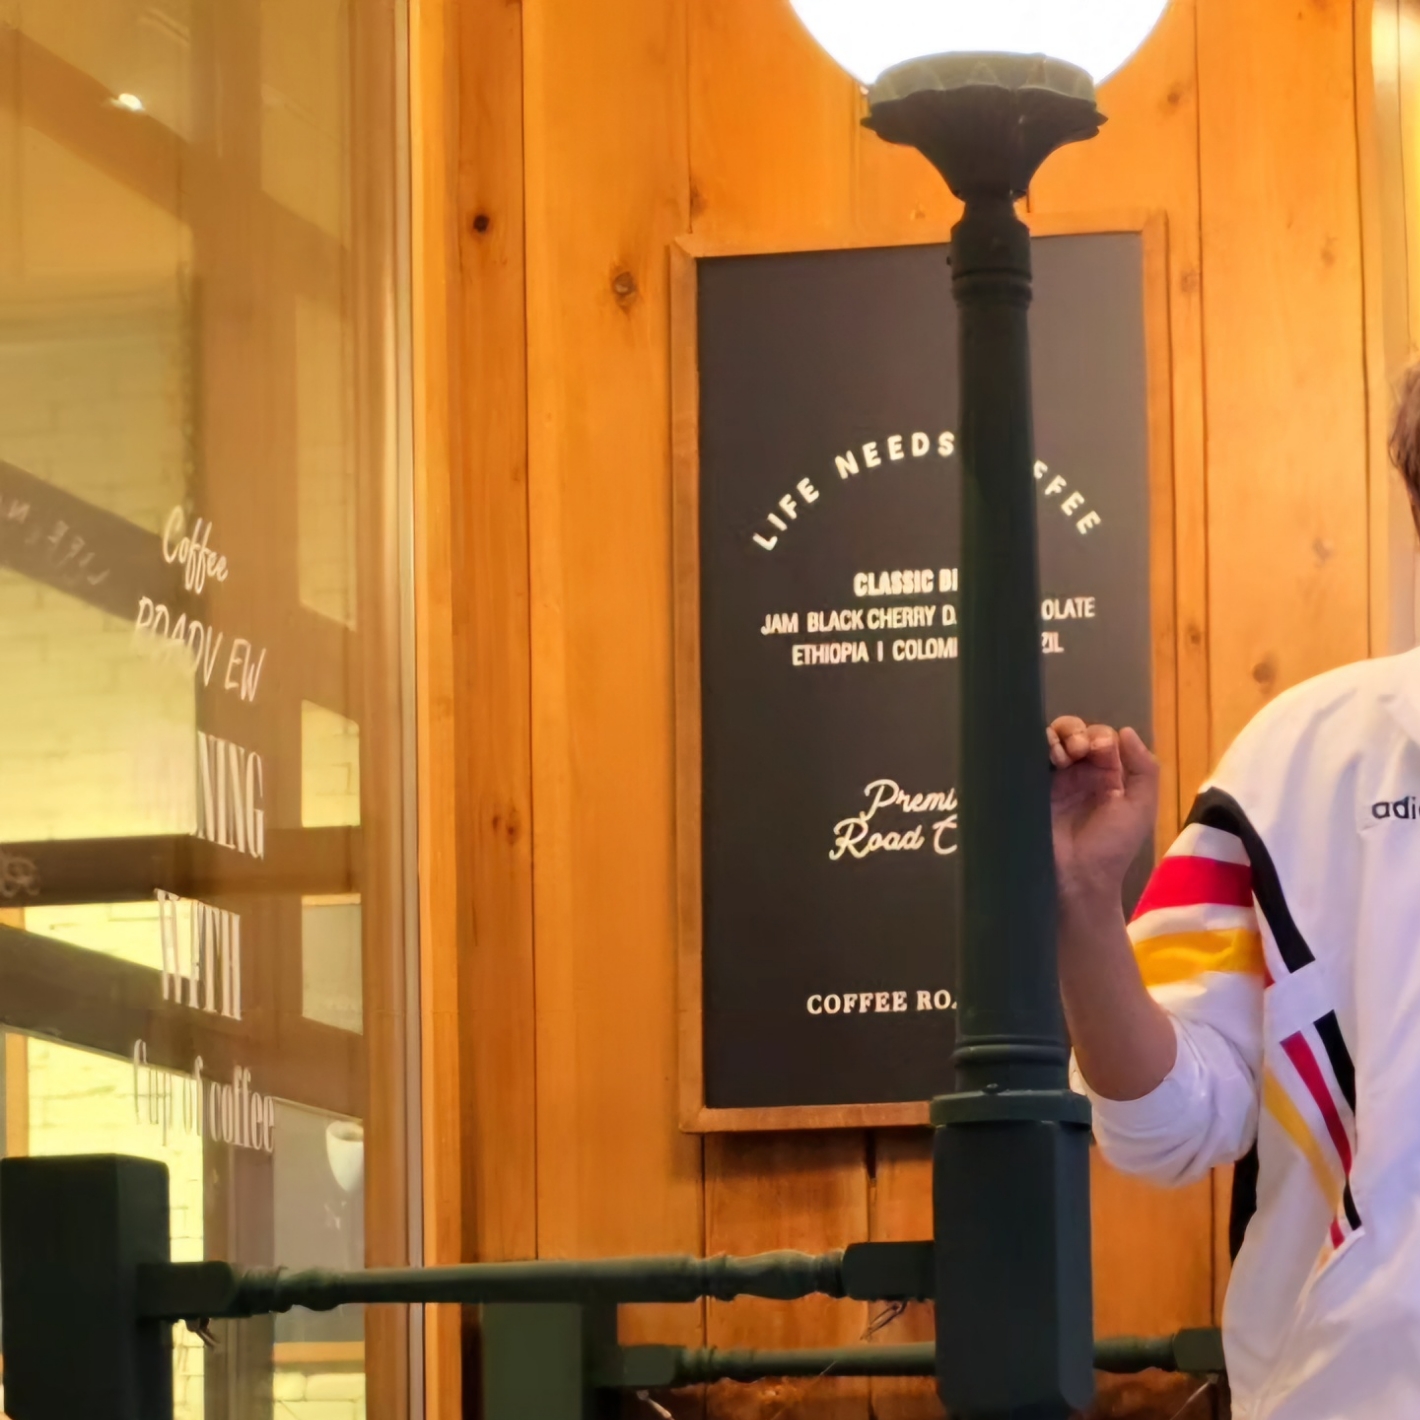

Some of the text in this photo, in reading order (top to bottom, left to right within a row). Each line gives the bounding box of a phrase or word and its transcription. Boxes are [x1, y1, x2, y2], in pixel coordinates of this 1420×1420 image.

[752, 477, 820, 551] LIFE
[835, 431, 956, 480] NEEDS
[162, 504, 229, 594] Coffee
[853, 569, 935, 597] CLASSIC
[760, 613, 799, 635] JAM
[806, 609, 864, 633] BLACK
[866, 605, 936, 630] CHERRY
[792, 641, 869, 667] ETHIOPIA
[859, 778, 957, 822] Premi
[829, 817, 925, 860] Road
[806, 989, 957, 1015] COFFEE RO
[209, 1065, 275, 1154] coffee
